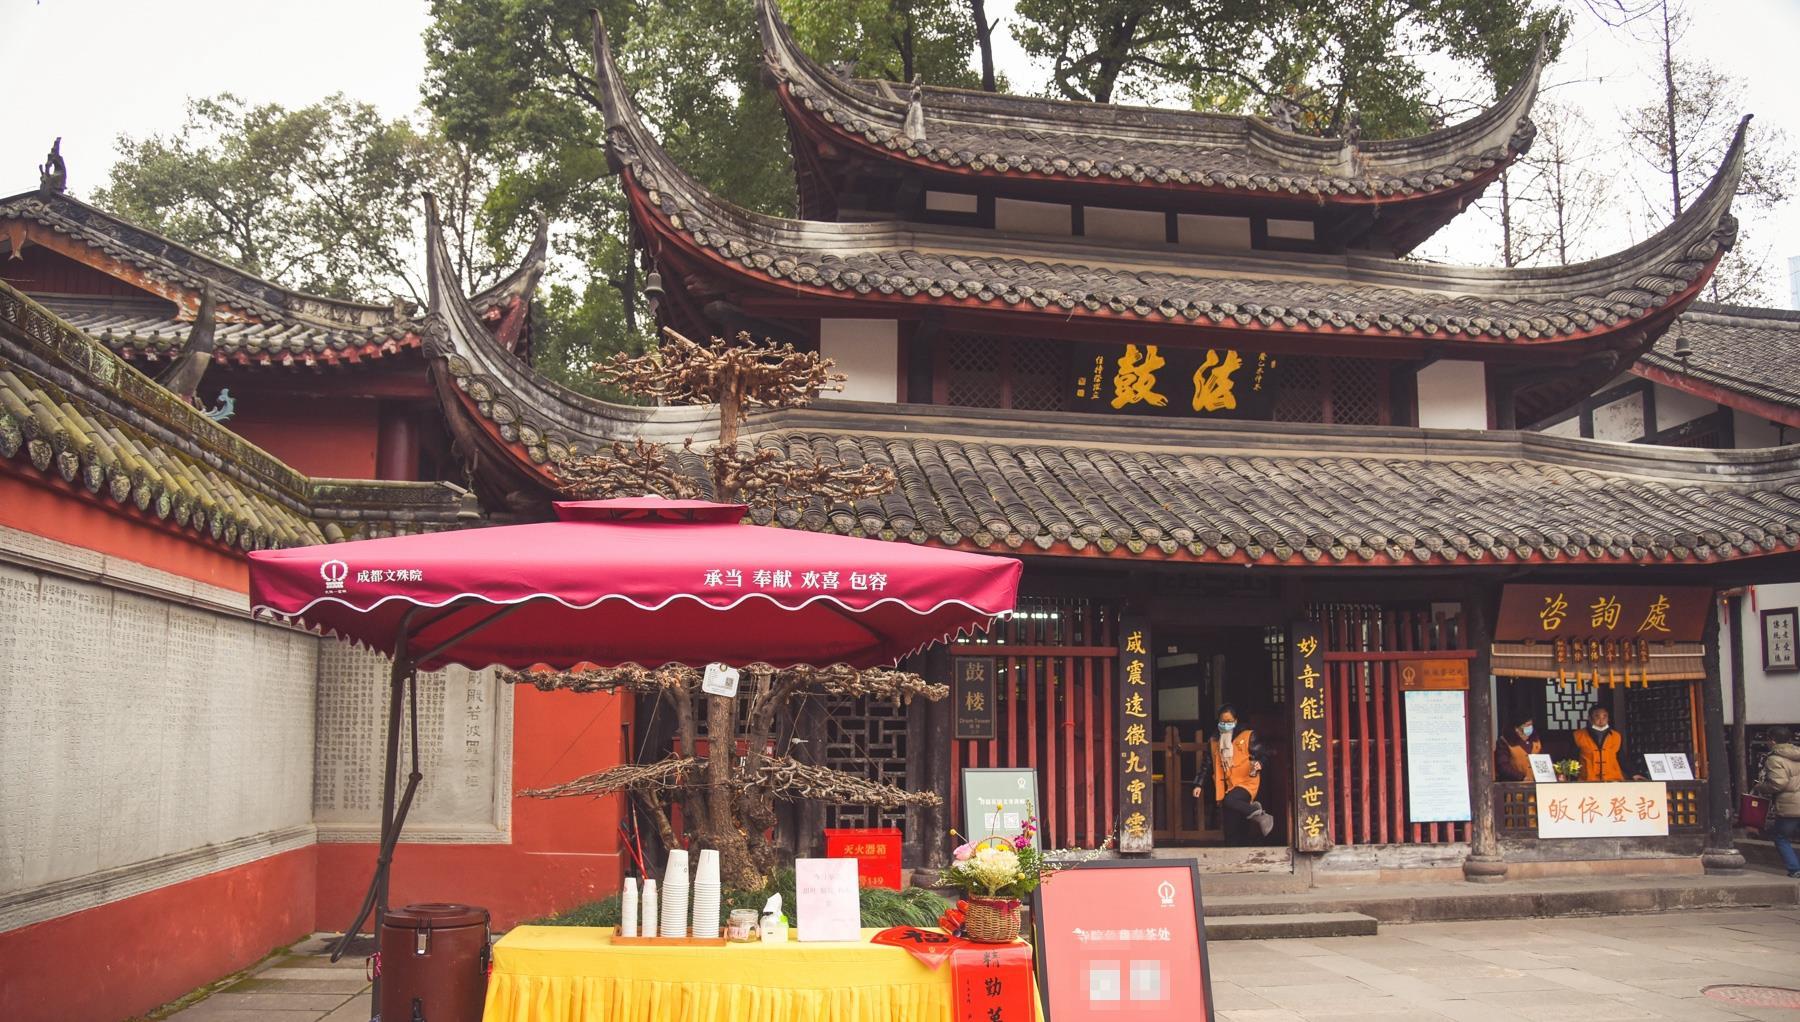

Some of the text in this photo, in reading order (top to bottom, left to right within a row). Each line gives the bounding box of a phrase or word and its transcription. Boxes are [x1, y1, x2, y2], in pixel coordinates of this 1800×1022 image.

[357, 569, 422, 583] 成都文殊院
[703, 569, 888, 591] 承当 奉献 欢喜 包容
[1297, 636, 1324, 838] 妙音能除三世苦
[1548, 796, 1661, 823] 皈依登記
[844, 844, 887, 855] 灭火器箱
